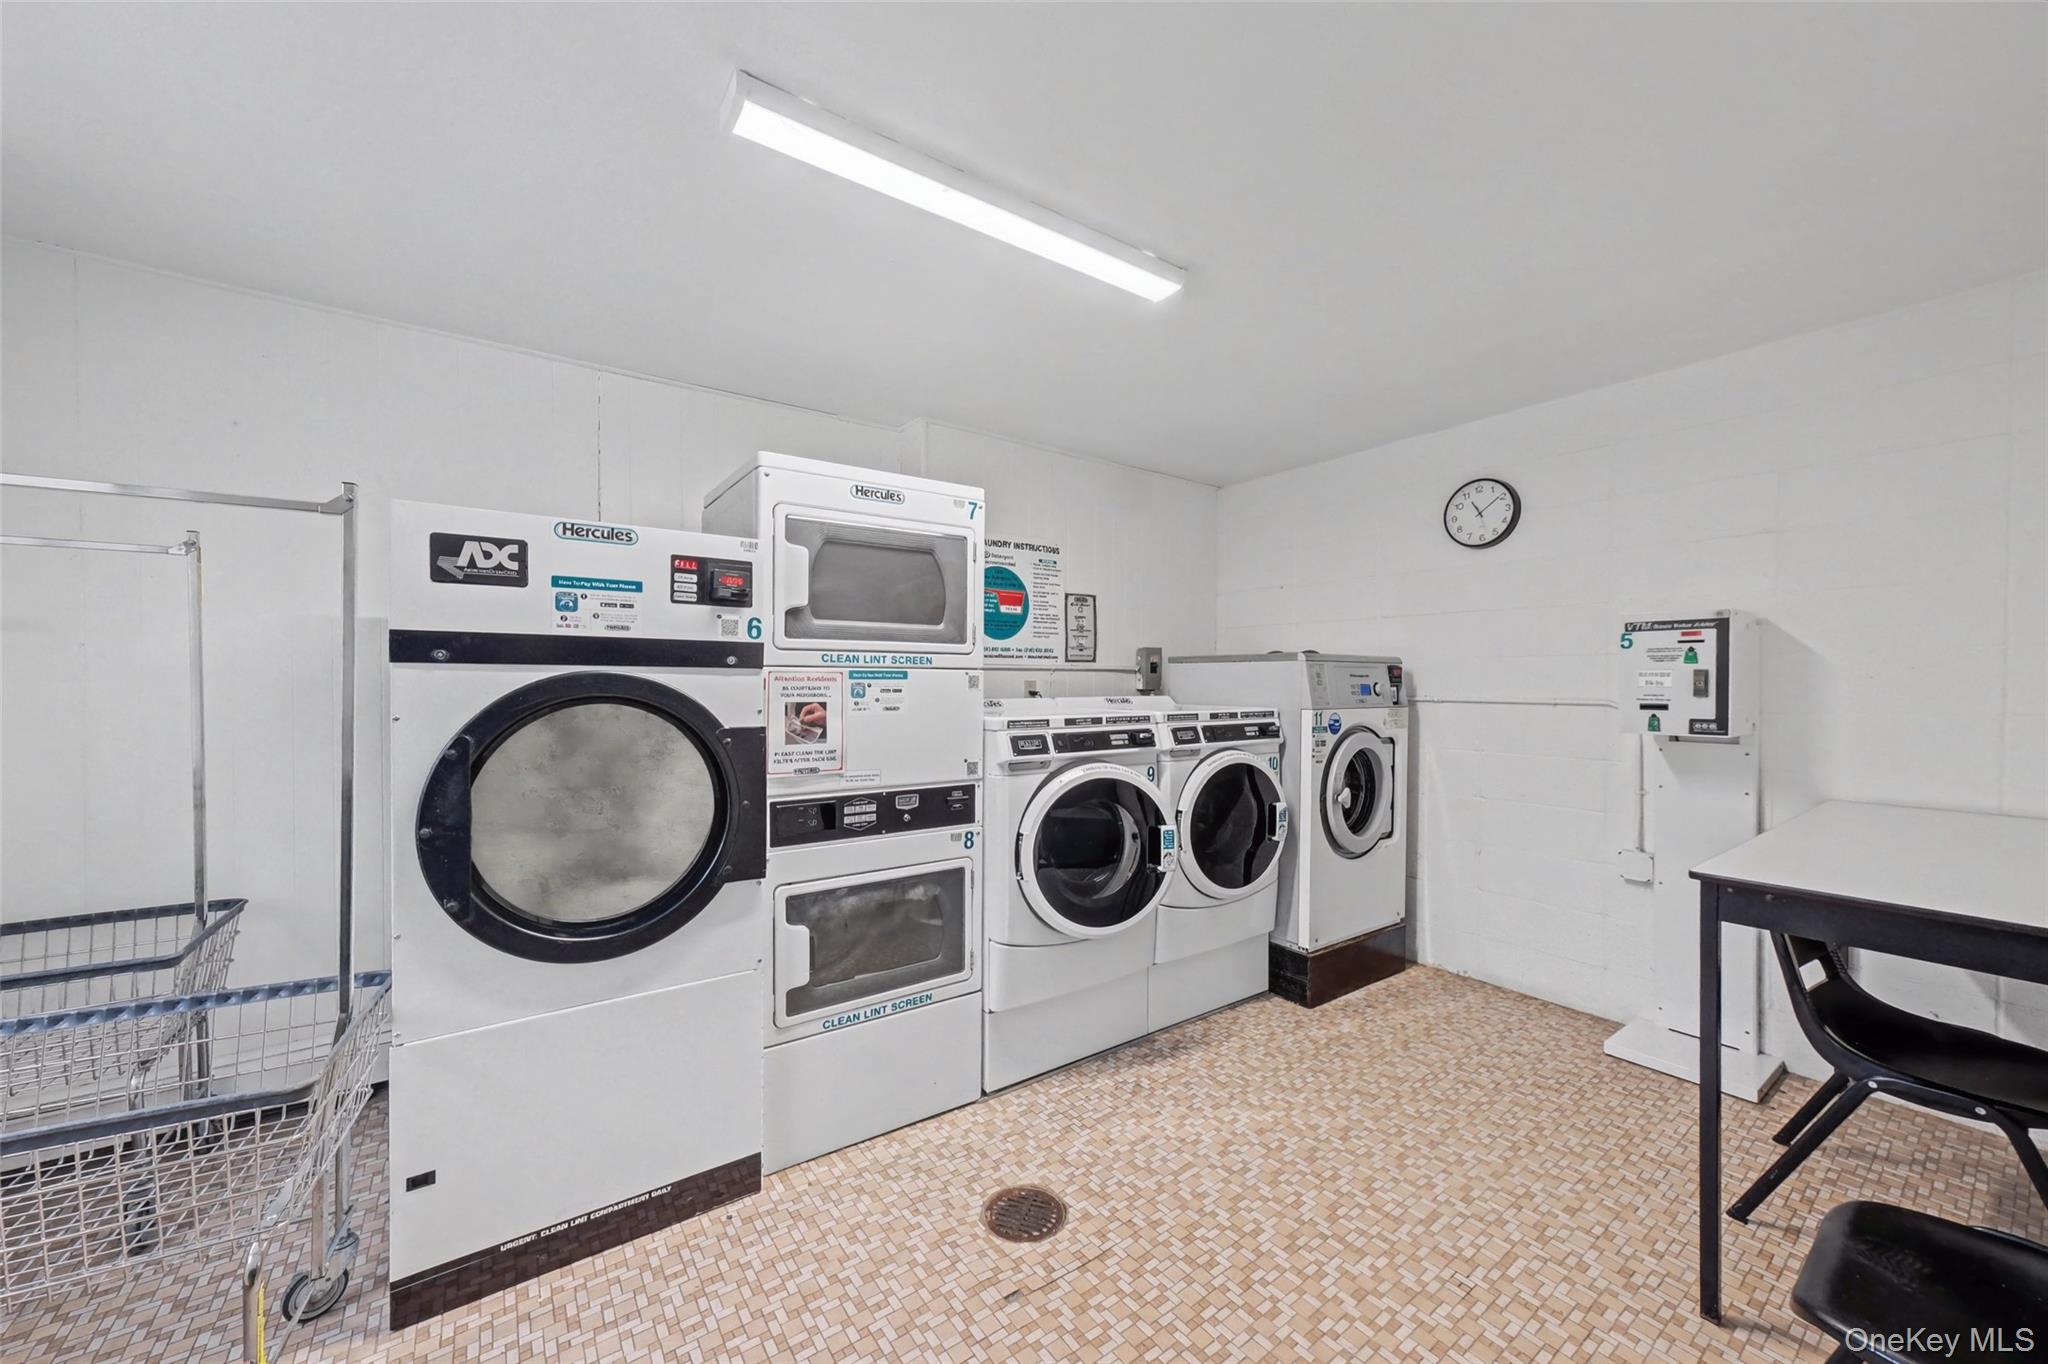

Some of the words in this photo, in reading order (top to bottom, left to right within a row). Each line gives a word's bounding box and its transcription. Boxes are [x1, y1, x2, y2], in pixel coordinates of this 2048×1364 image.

[855, 485, 903, 502] Hercules
[968, 501, 978, 520] 7
[562, 522, 634, 543] Hercules
[456, 540, 519, 571] ADC
[1013, 541, 1060, 555] INSTRUCTIONS
[747, 617, 762, 639] 6
[1620, 632, 1633, 649] 5
[821, 653, 860, 664] CLEAN
[863, 655, 887, 664] LINT
[891, 655, 933, 666] SCREEN
[774, 674, 804, 683] Attention
[1314, 711, 1323, 726] 11
[1269, 756, 1279, 770] 10
[1147, 766, 1155, 783] 9
[964, 831, 975, 850] 8
[822, 1012, 861, 1029] CLEAN
[863, 1005, 888, 1019] LINT
[891, 993, 933, 1012] SCREEN
[540, 1223, 568, 1238] CLEAN
[570, 1214, 588, 1227] LINT
[590, 1195, 650, 1220] COMPARTMENT
[651, 1185, 672, 1198] DAILY
